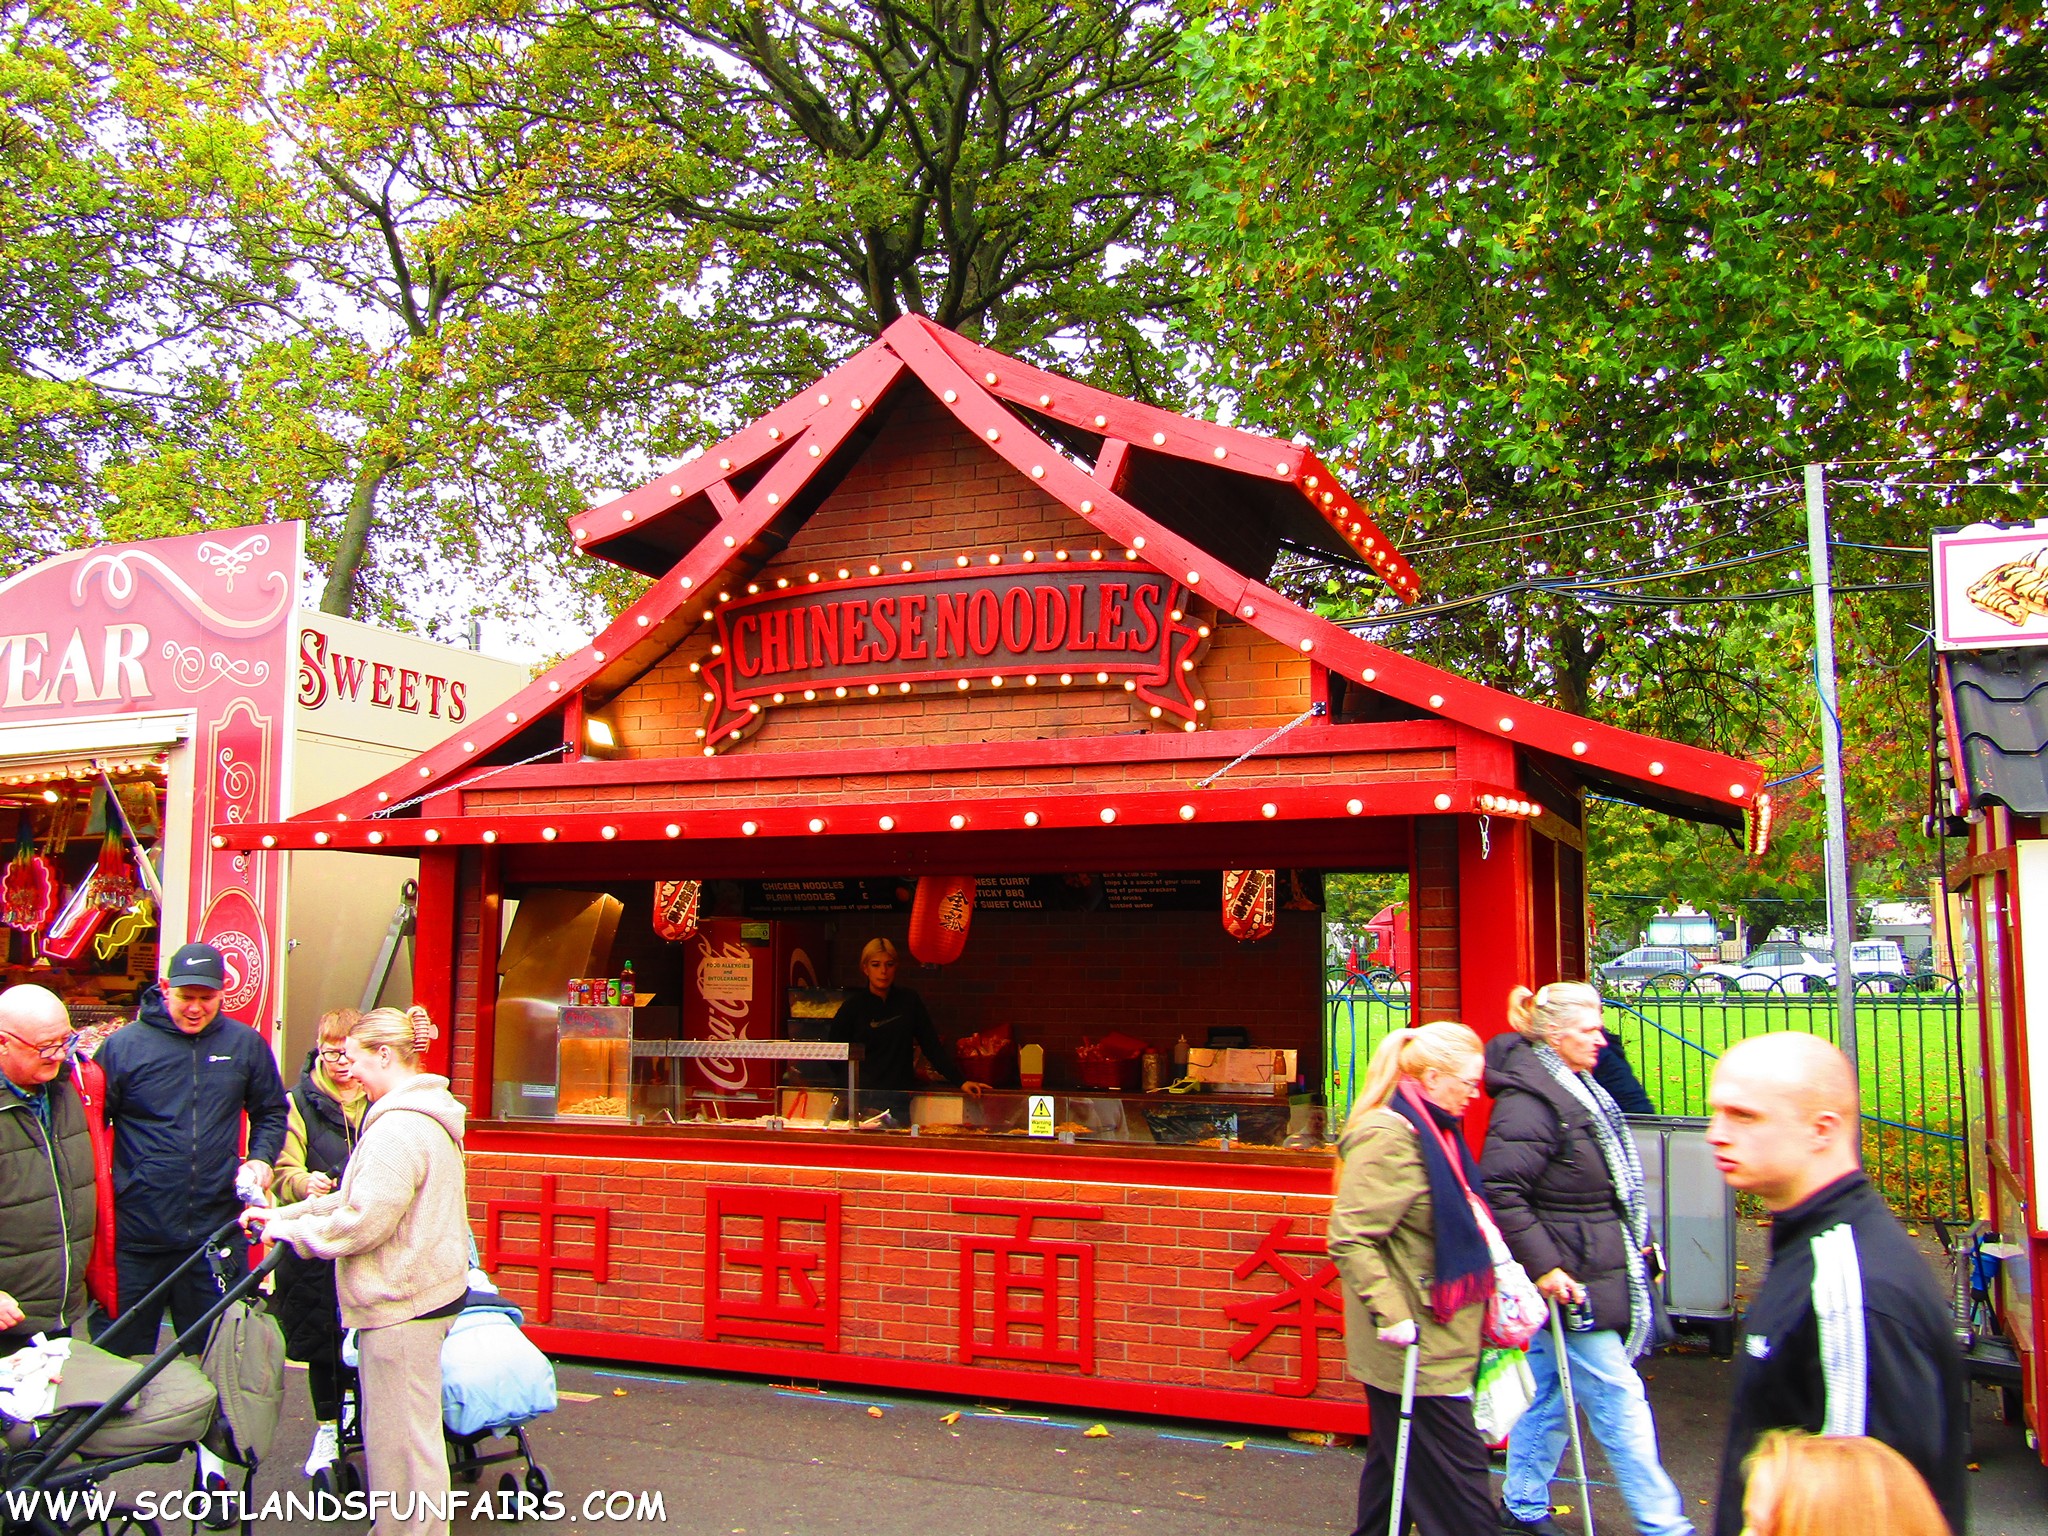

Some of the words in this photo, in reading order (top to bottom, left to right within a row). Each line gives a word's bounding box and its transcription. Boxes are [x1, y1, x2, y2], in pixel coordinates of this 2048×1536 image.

[732, 594, 928, 678] CHINESE
[935, 582, 1160, 658] NOODLES
[298, 628, 468, 724] SWEETS
[762, 881, 800, 891] CHICKEN
[802, 880, 845, 890] NOODLES
[1000, 877, 1030, 886] CURRY
[765, 893, 793, 902] PLAIN
[795, 892, 836, 901] NOODLES
[1006, 889, 1025, 898] BBQ
[980, 900, 1010, 909] SWEET
[1012, 900, 1043, 909] CHILLI
